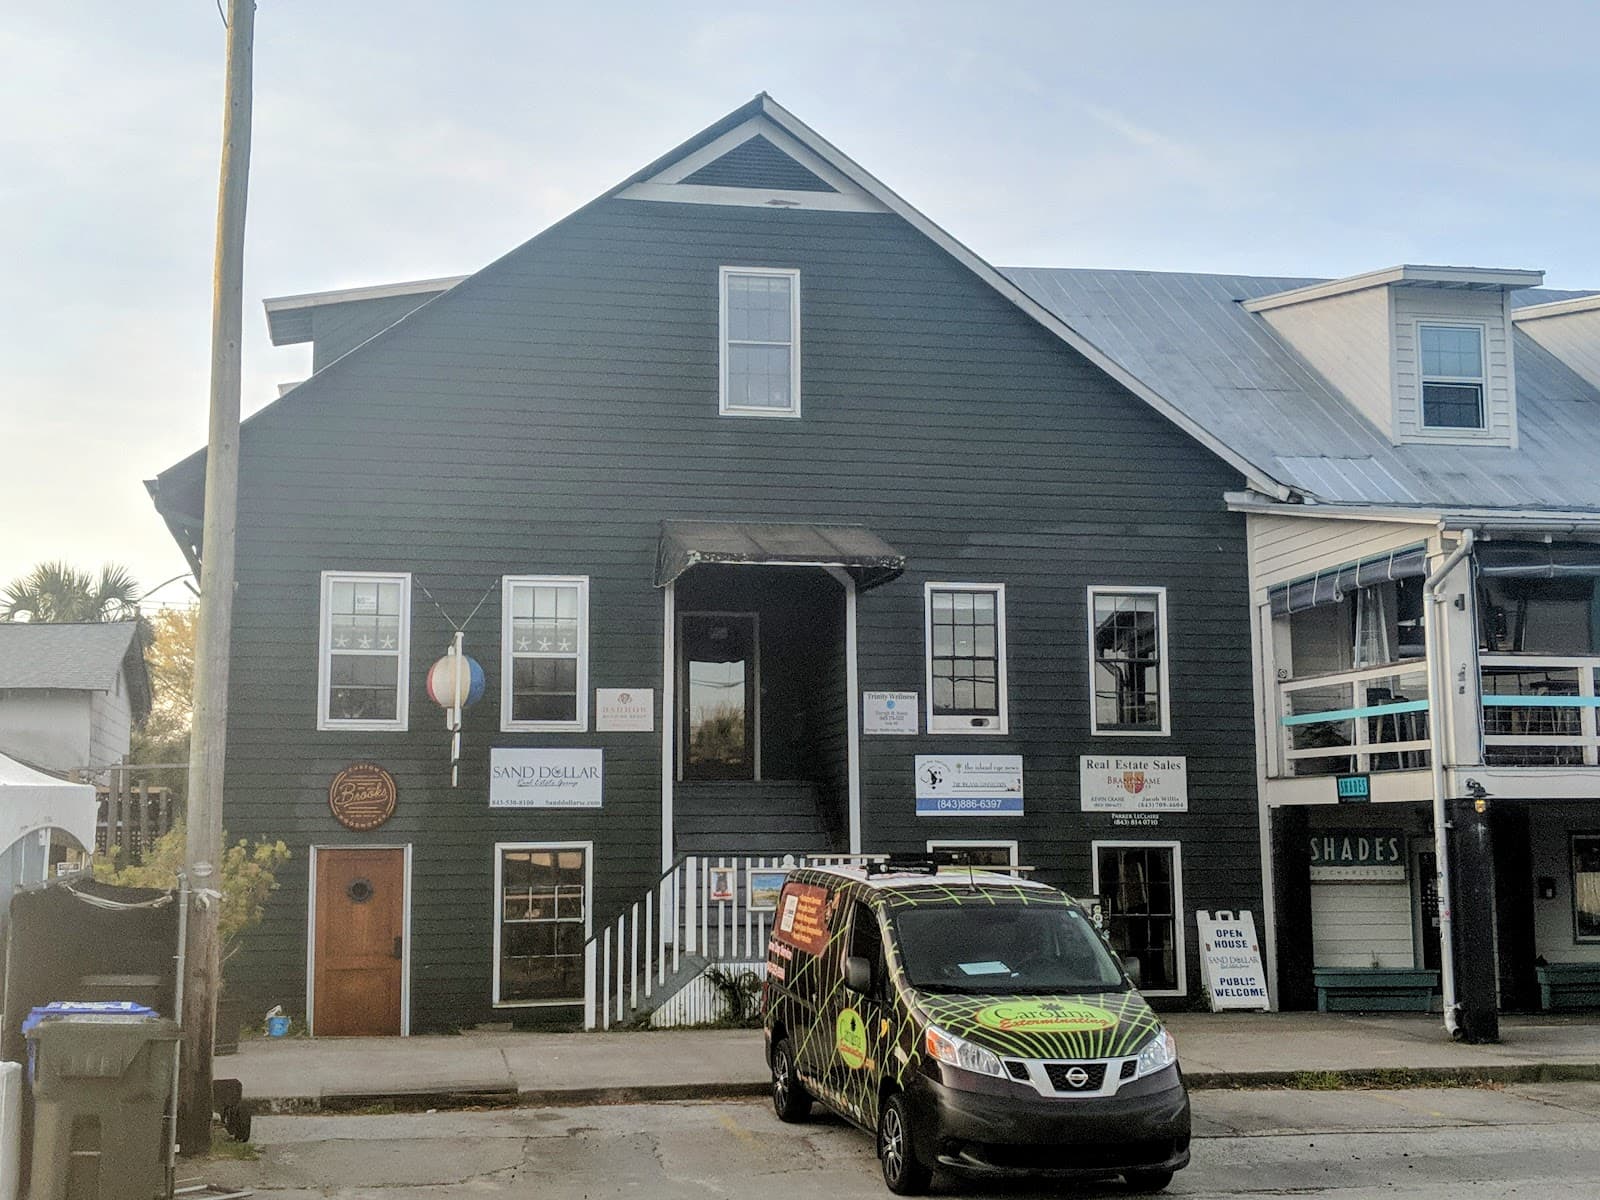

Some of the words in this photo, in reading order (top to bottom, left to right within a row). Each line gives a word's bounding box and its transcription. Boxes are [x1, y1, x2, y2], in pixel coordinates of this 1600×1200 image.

[1086, 760, 1110, 770] Real
[1115, 760, 1149, 770] Estate
[1153, 760, 1181, 770] Sales
[493, 766, 535, 778] SAND
[539, 766, 600, 778] DOLLAR
[937, 799, 1002, 810] (843)886-6397
[1310, 837, 1399, 861] SHADES
[1216, 929, 1243, 938] OPEN
[1214, 940, 1248, 948] HOUSE
[1220, 978, 1256, 986] PUBLIC
[1214, 988, 1266, 997] WELCOME
[994, 1008, 1095, 1020] Carolina
[999, 1017, 1109, 1030] Exterminating
